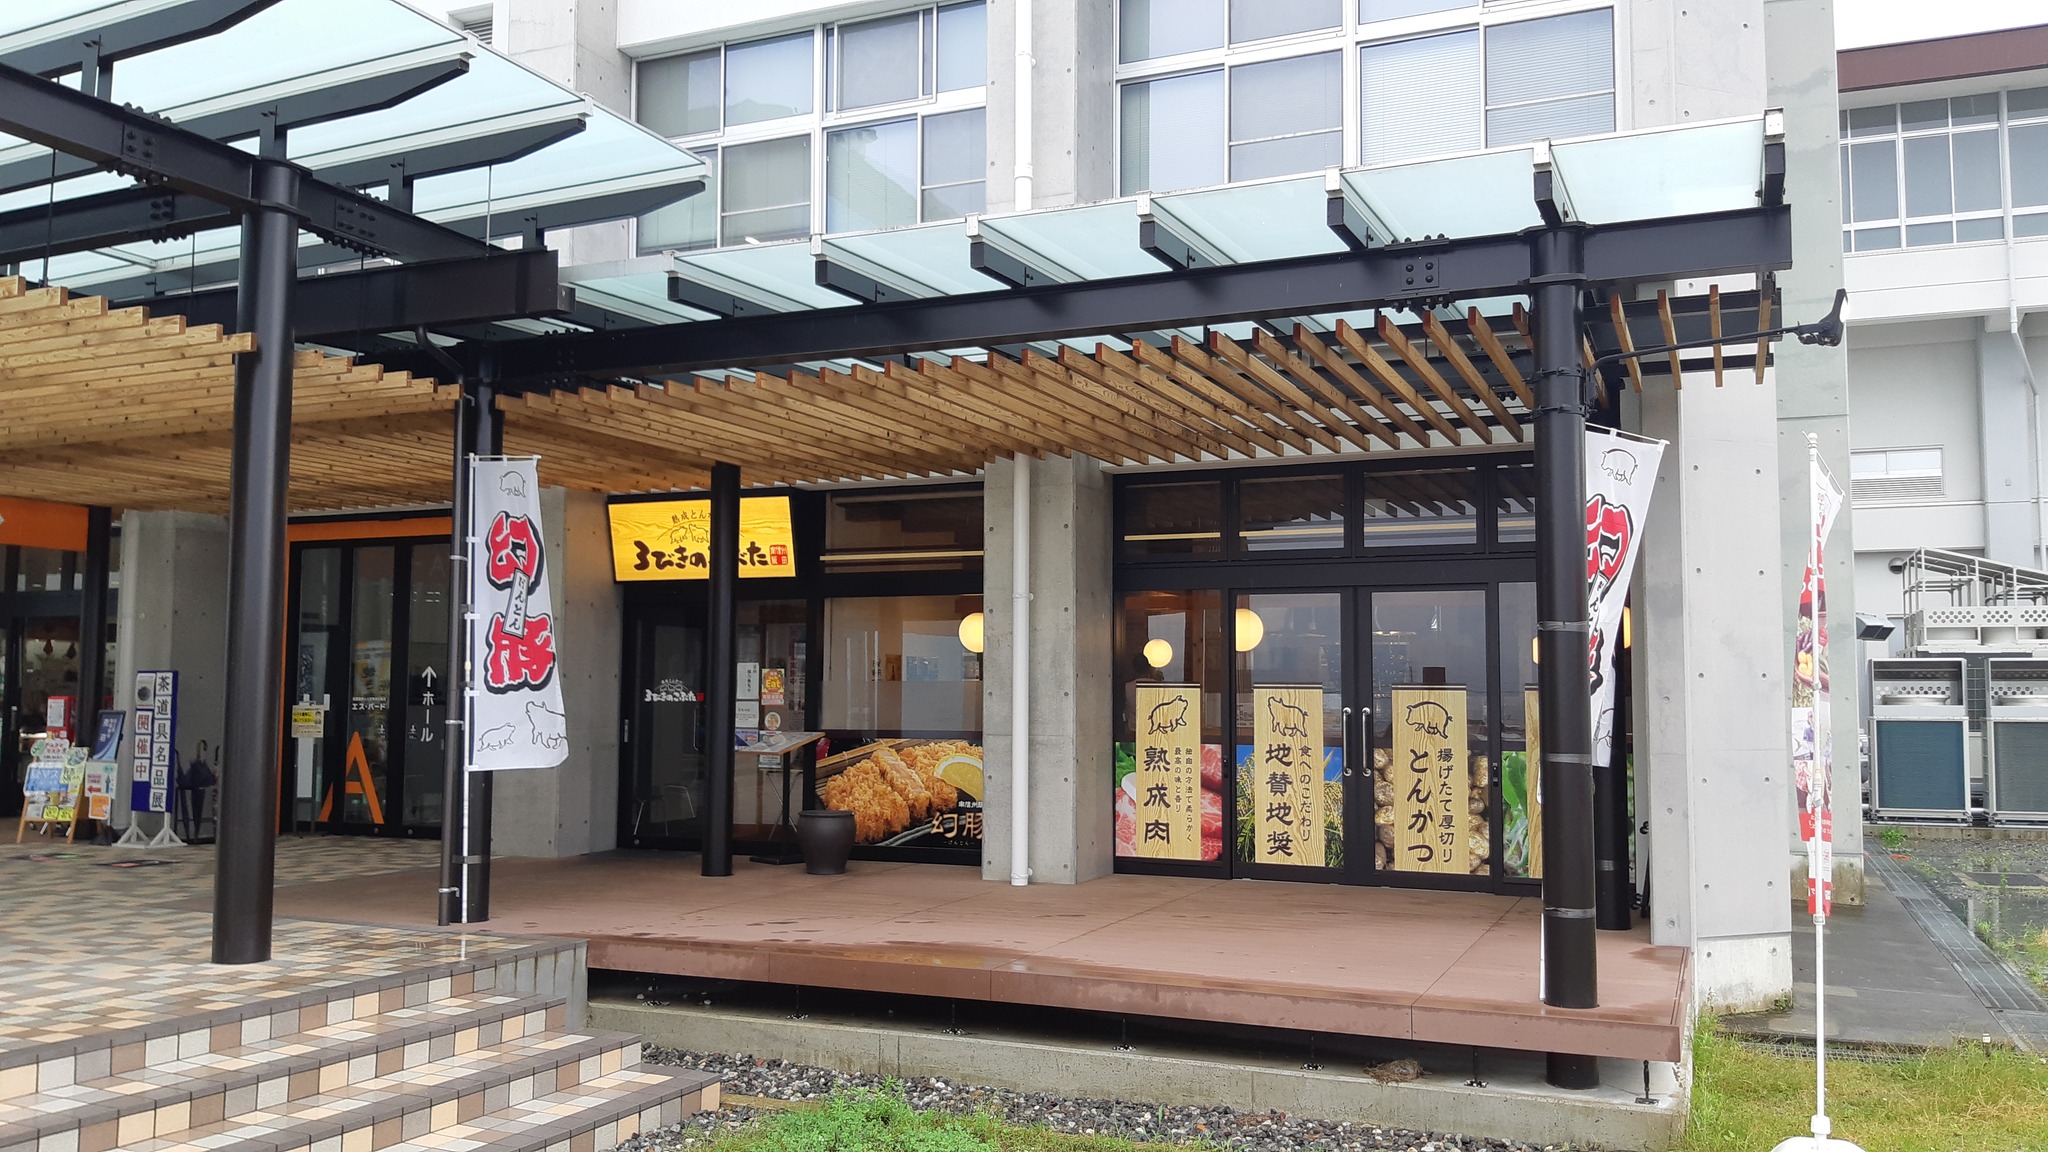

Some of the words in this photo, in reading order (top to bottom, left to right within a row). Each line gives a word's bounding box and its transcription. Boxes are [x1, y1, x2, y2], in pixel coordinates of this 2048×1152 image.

[136, 714, 150, 779] 開催中
[151, 674, 170, 810] 茶道具名品展
[420, 691, 435, 742] ホール
[1143, 745, 1171, 845] 熟成肉
[1265, 743, 1294, 857] 地賛地奨
[1299, 745, 1312, 842] 食へのこだわり
[1407, 748, 1434, 862] とんかつ
[1437, 748, 1455, 863] 揚げたて厚切り
